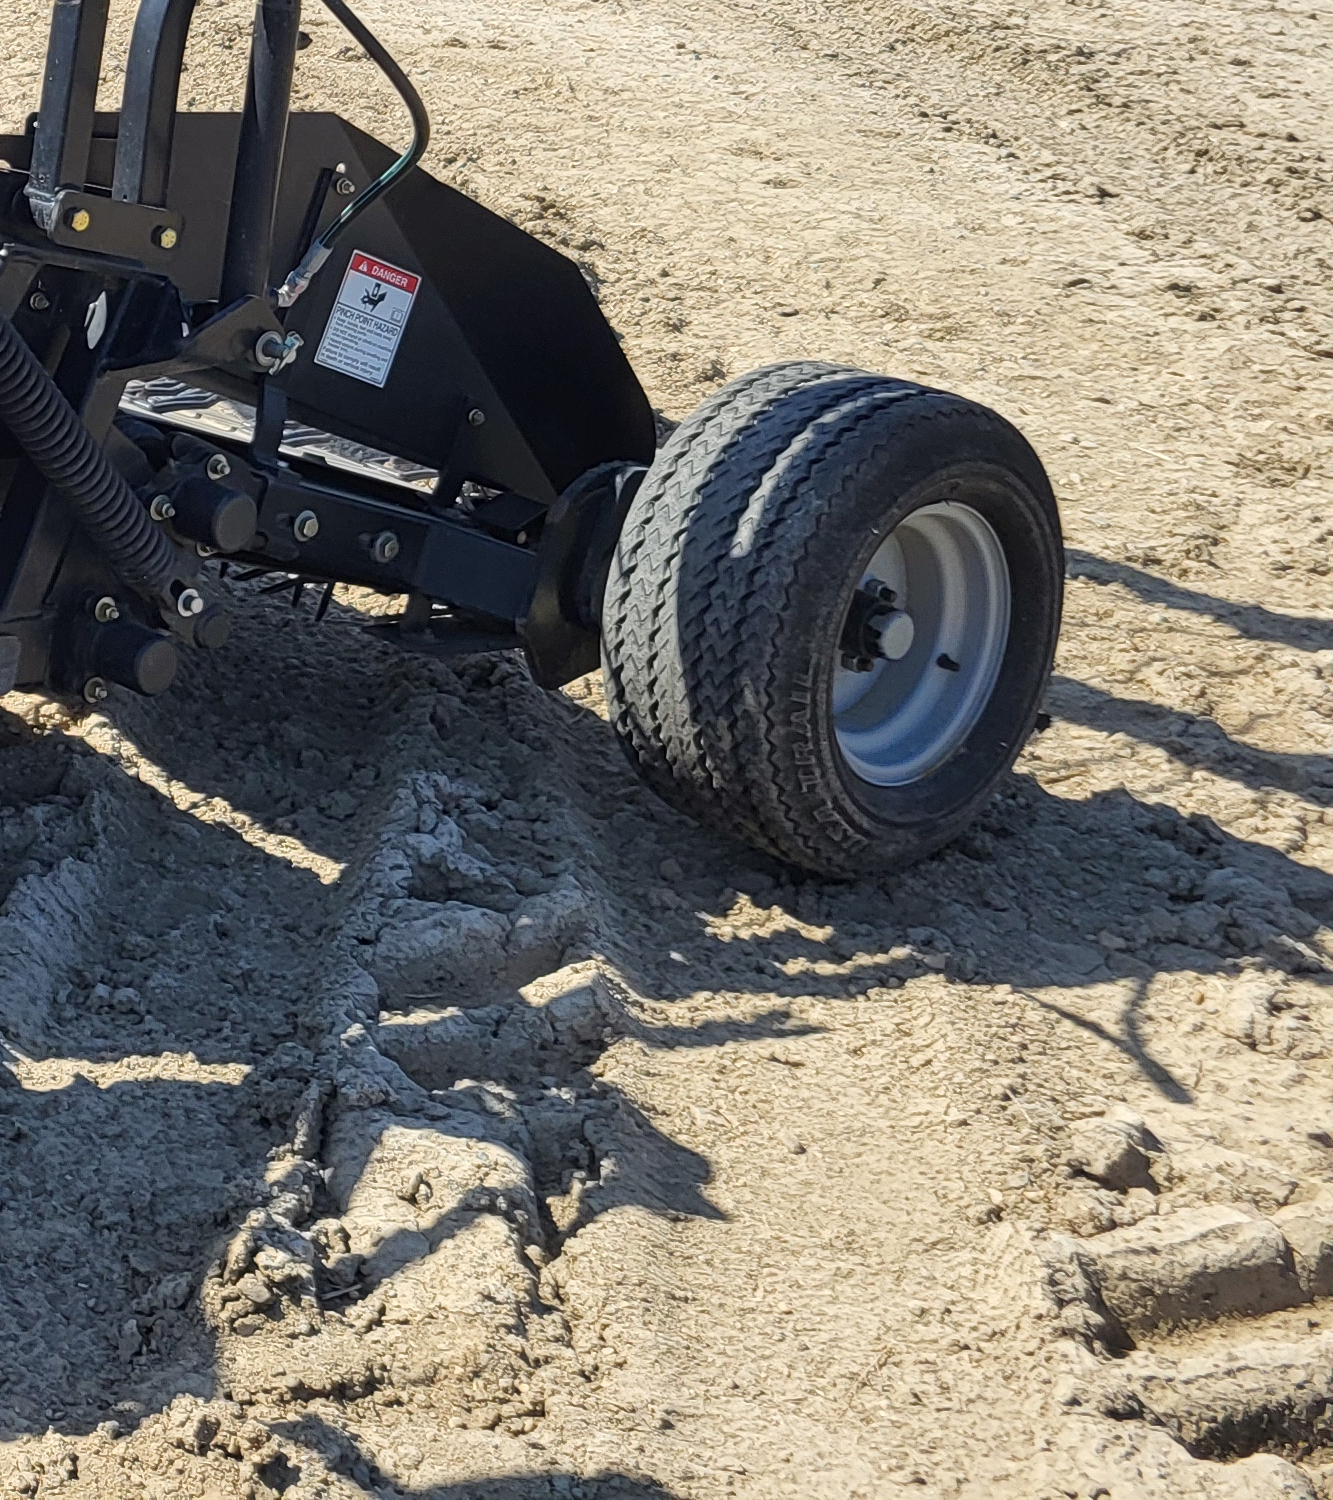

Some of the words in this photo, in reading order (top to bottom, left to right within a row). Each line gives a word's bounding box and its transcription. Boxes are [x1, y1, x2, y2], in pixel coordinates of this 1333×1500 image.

[371, 265, 408, 287] DANGER
[336, 306, 355, 320] PINCH
[355, 312, 374, 328] POINT
[373, 320, 399, 337] HAZARD
[788, 652, 821, 793] TRAIL
